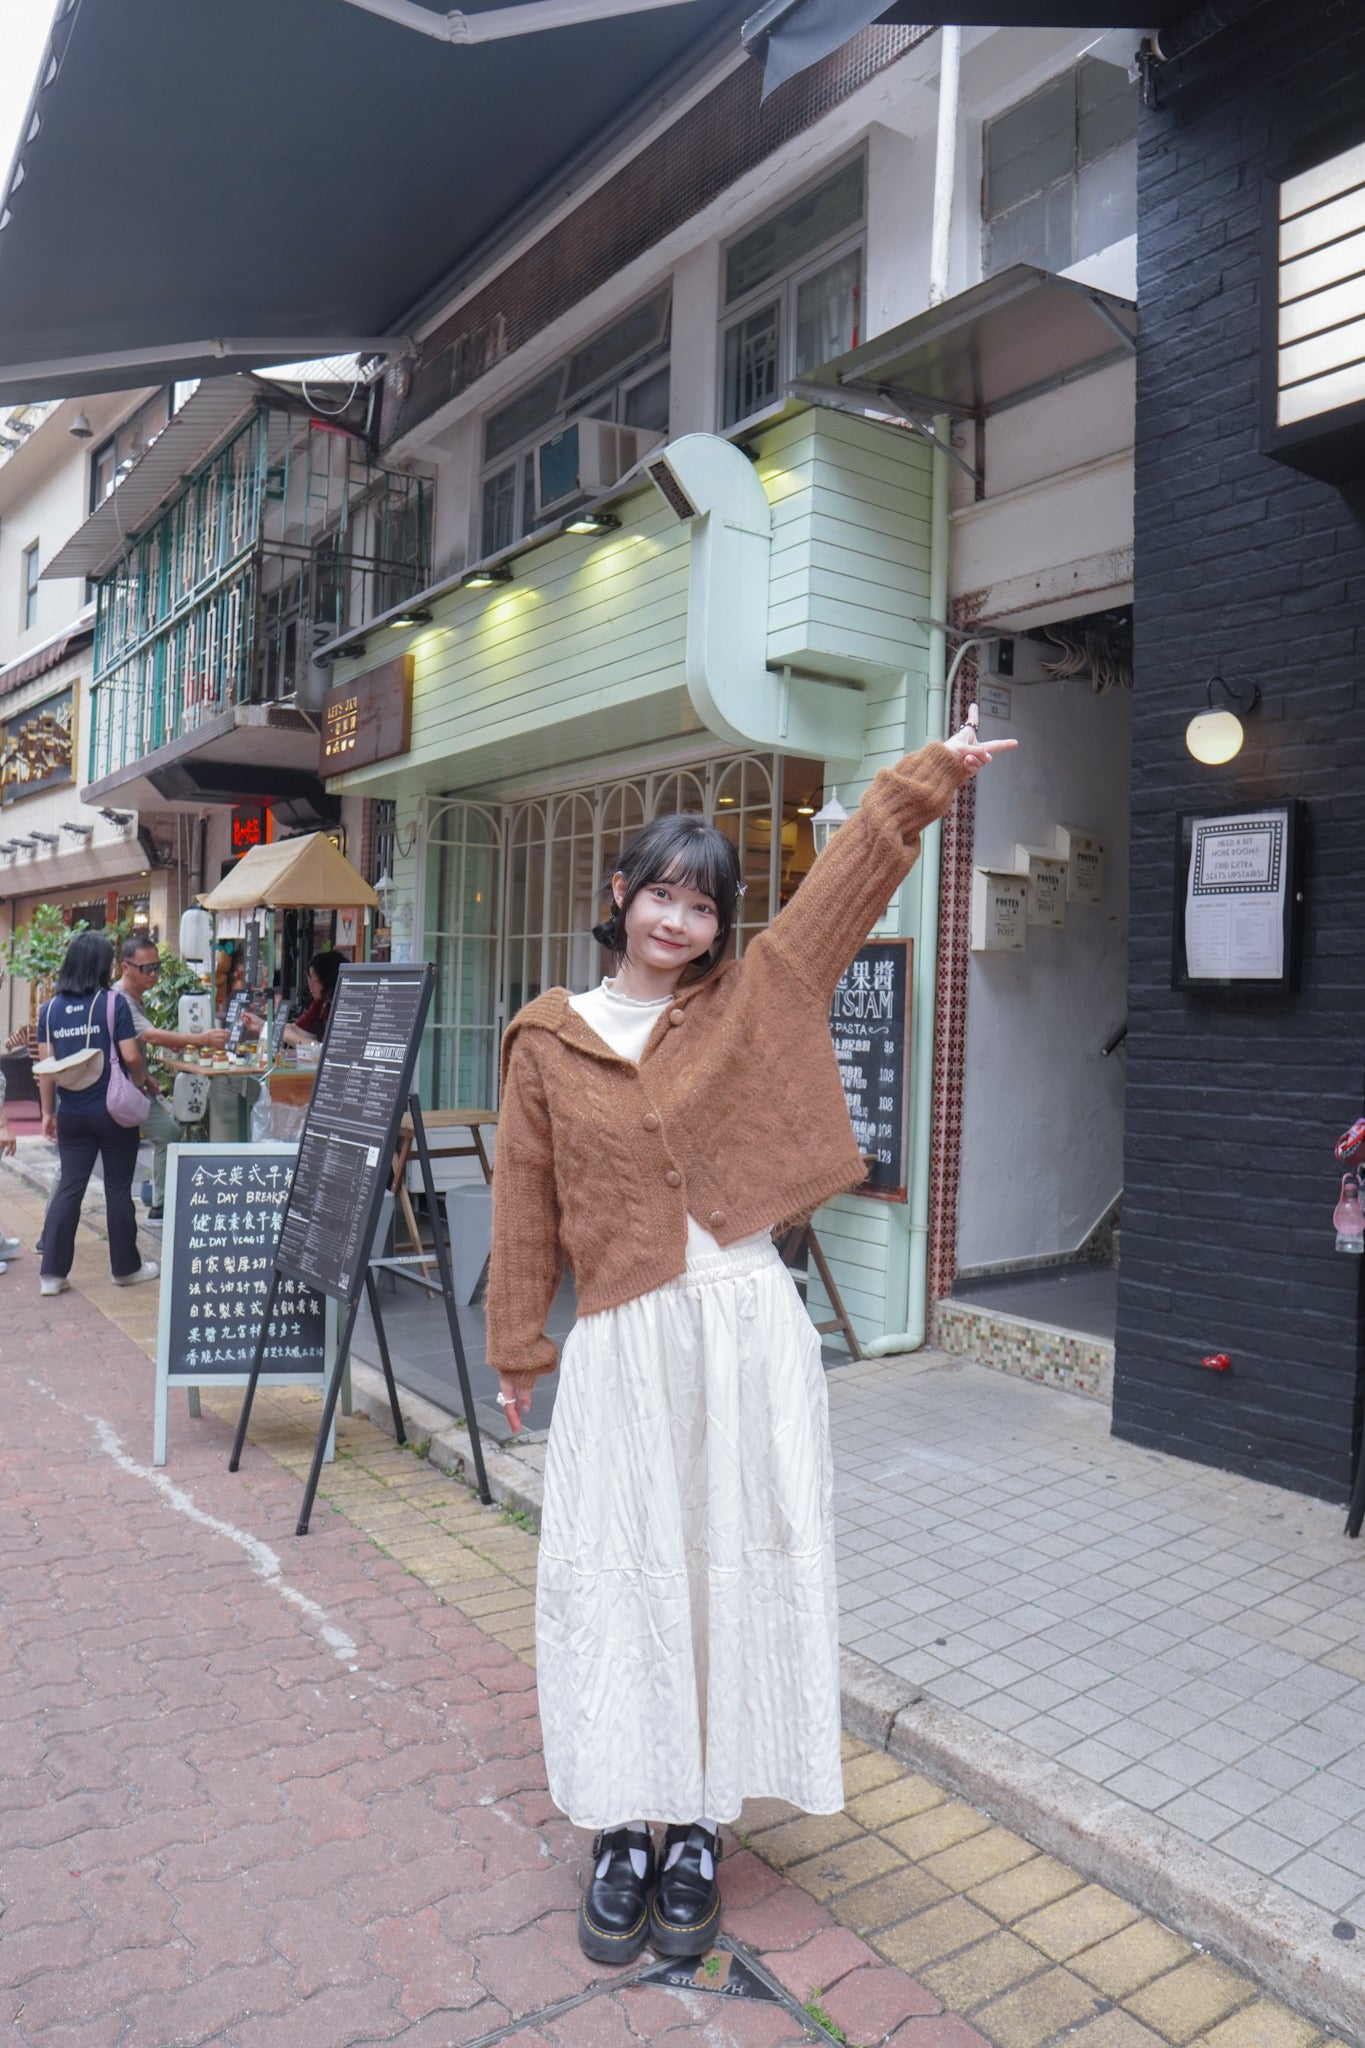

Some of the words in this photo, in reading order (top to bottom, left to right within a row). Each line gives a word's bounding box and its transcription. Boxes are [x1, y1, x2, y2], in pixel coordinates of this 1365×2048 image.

[1231, 860, 1254, 869] EXTRA
[1037, 874, 1059, 884] POSTES
[995, 897, 1019, 908] POSTES
[997, 928, 1014, 937] POST
[829, 990, 894, 1019] TSJAM
[53, 1024, 101, 1039] education
[835, 1022, 868, 1035] PASTA
[884, 1040, 894, 1054] 98
[879, 1068, 893, 1083] 108
[878, 1096, 893, 1112] 108
[877, 1123, 892, 1138] 108
[877, 1148, 891, 1164] 128
[190, 1192, 209, 1206] ALL
[216, 1192, 239, 1205] DAY
[189, 1236, 207, 1248] ALL
[209, 1236, 228, 1247] DAY
[191, 1255, 273, 1274] 自家製厚切
